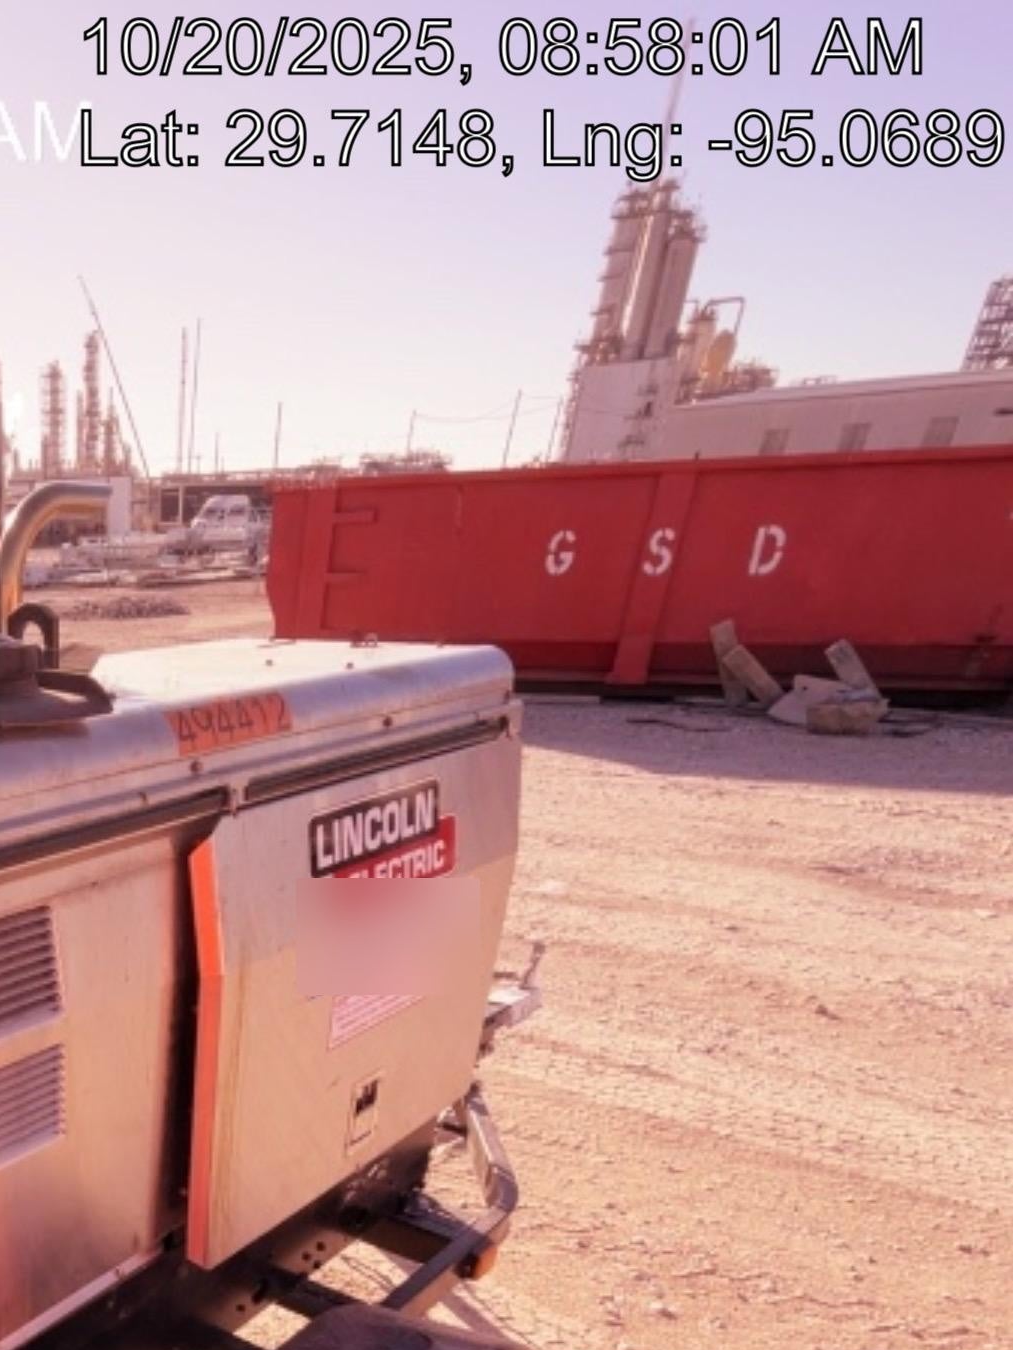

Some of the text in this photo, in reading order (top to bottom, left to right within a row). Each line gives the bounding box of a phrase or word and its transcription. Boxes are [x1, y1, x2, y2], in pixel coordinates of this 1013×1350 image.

[544, 523, 787, 576] G S D
[172, 691, 292, 753] 494412
[315, 788, 435, 870] LINCOLN
[348, 839, 446, 879] ECTRIC
